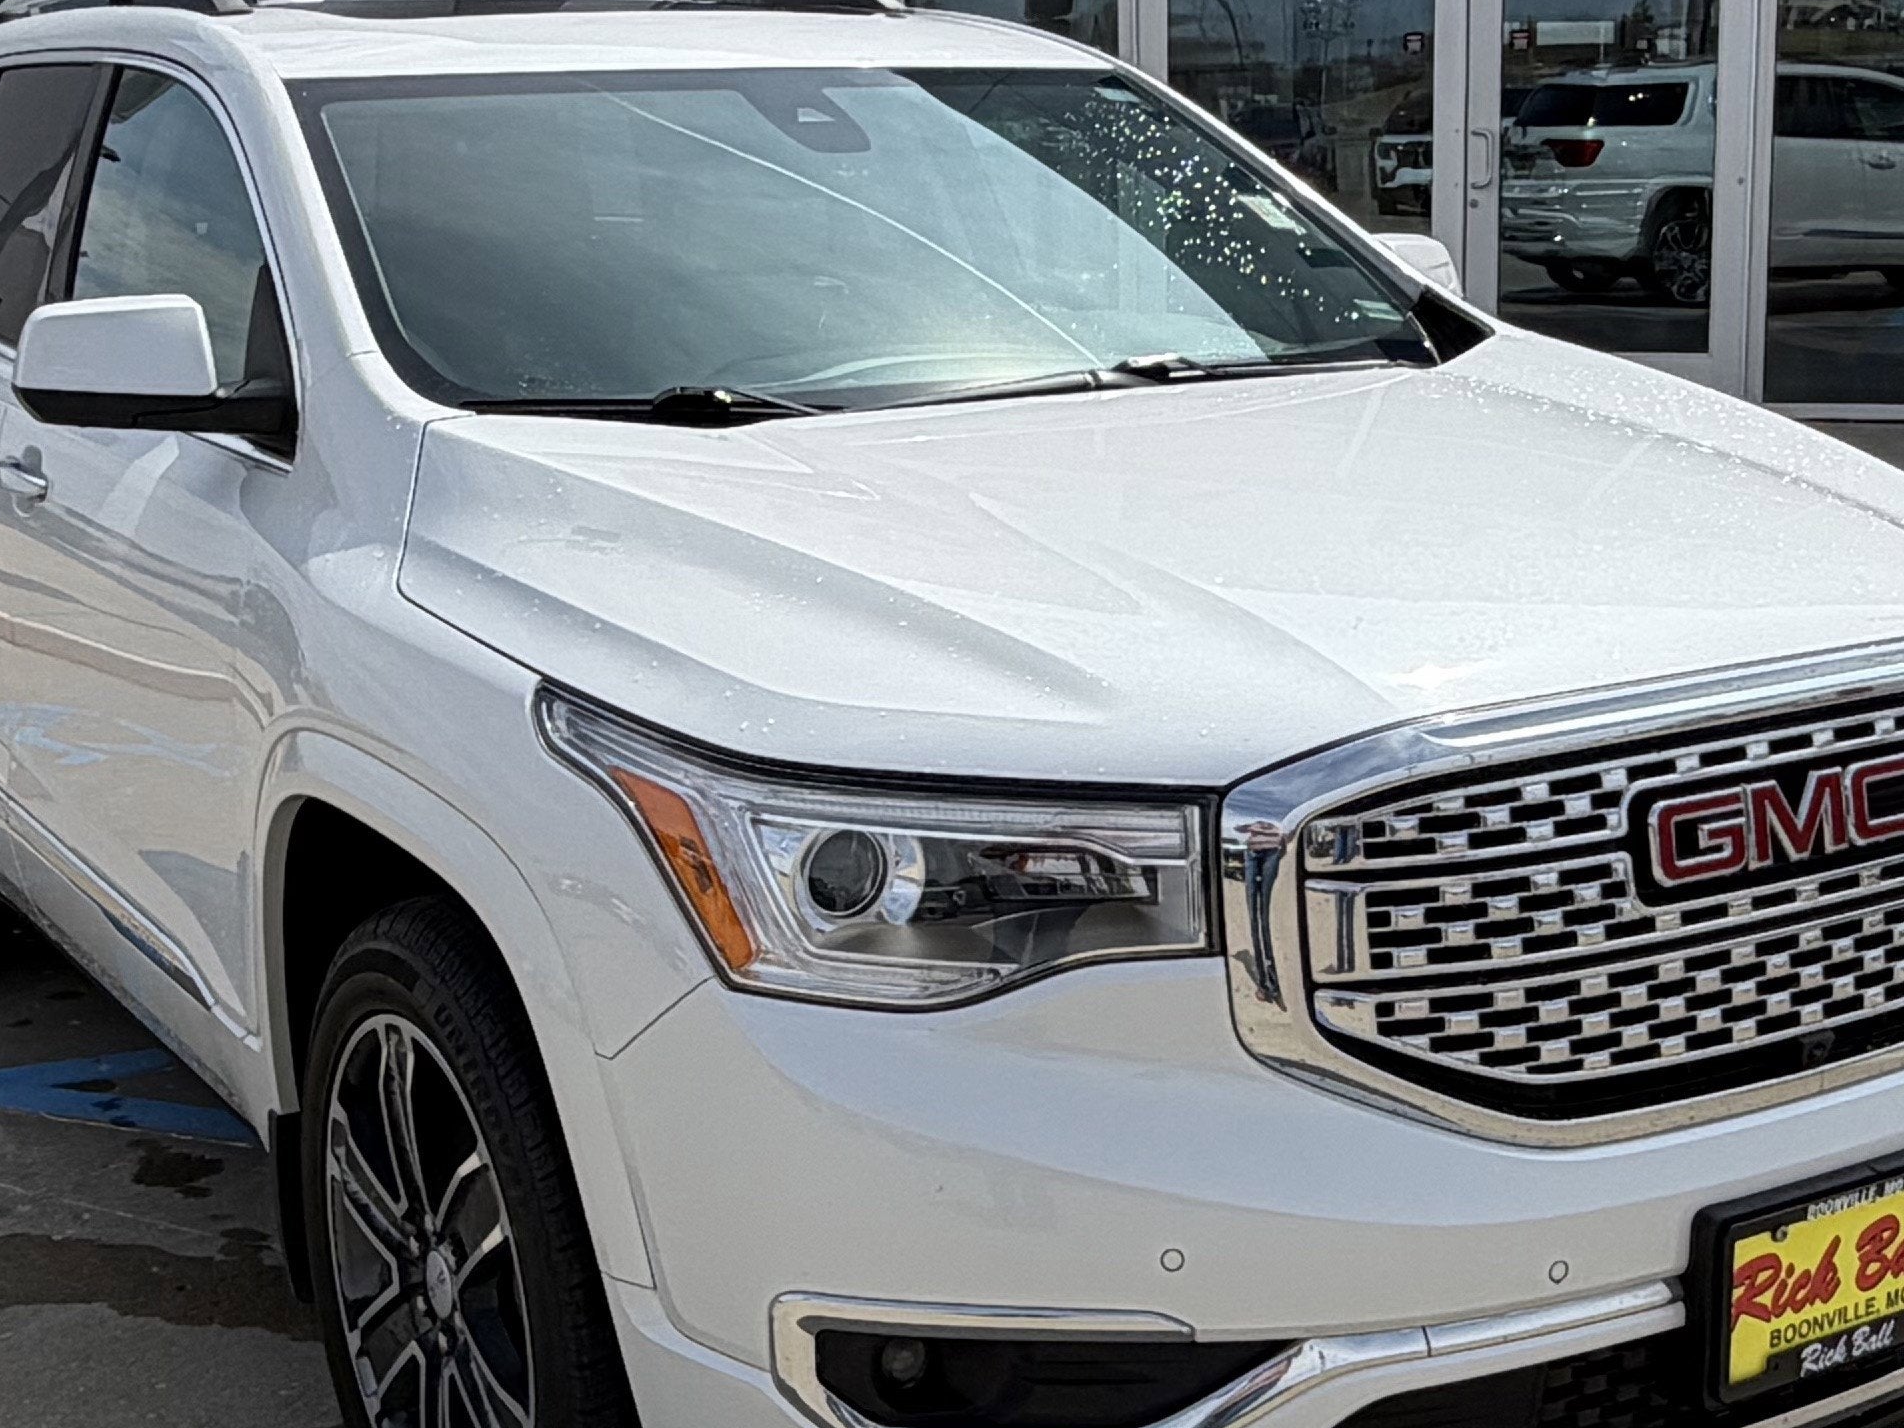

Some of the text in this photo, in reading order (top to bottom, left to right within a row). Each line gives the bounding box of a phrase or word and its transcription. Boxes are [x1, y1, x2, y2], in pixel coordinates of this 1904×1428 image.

[1731, 1234, 1841, 1333] Rick
[1769, 1296, 1879, 1348] BOONVILLE,
[1800, 1319, 1895, 1377] Rick Ball
